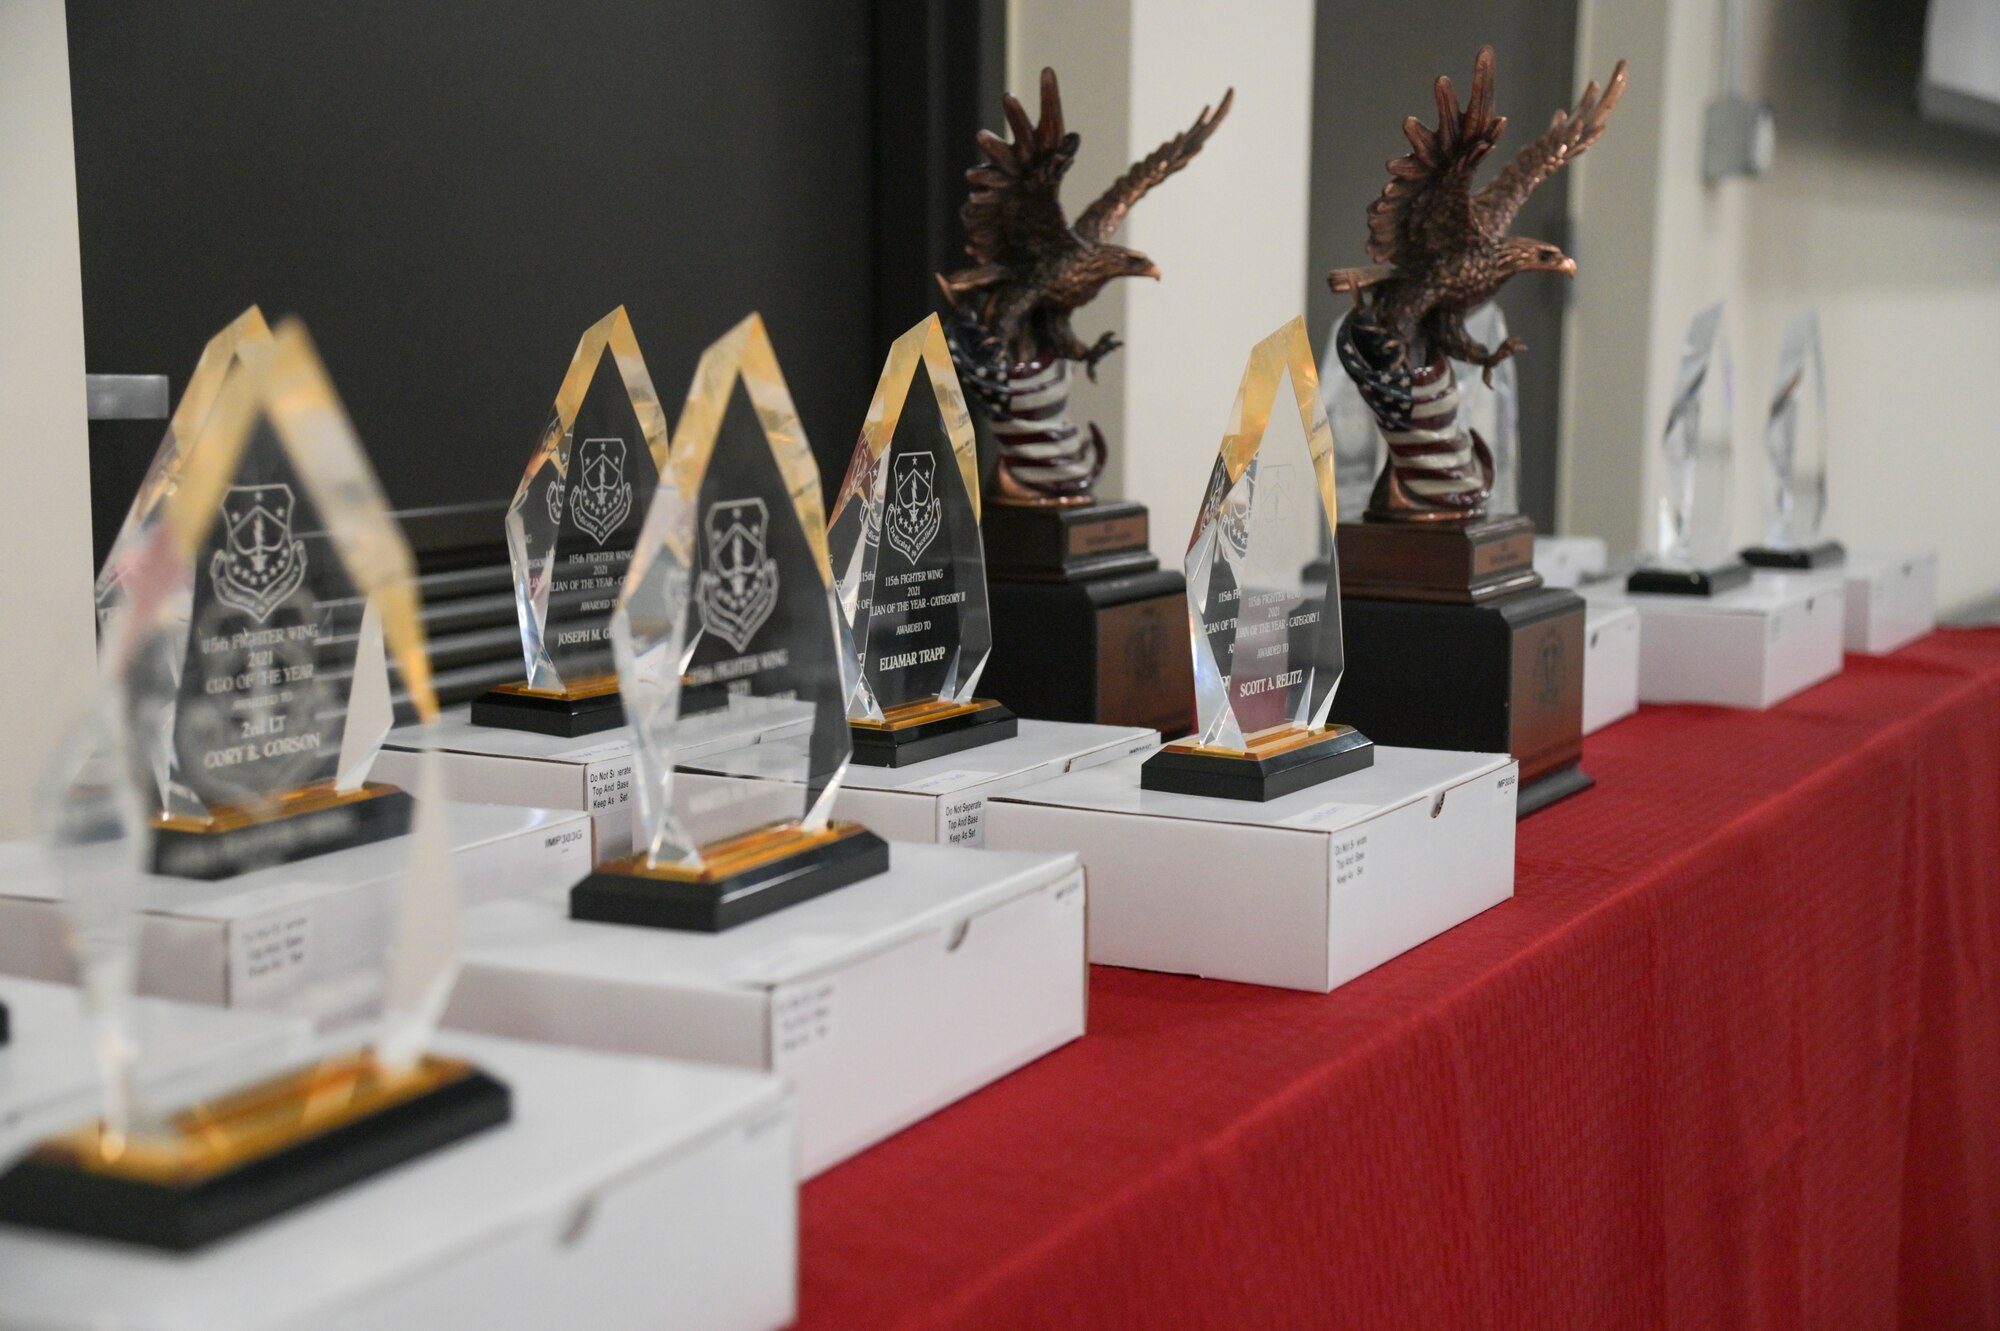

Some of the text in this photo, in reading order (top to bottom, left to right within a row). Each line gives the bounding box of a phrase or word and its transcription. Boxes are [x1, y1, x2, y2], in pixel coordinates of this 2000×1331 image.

[586, 551, 614, 563] FIGHTER
[594, 565, 608, 575] 2021
[886, 568, 944, 586] 115th FIGHTER WING
[570, 580, 579, 590] OF
[581, 579, 594, 590] THE
[596, 577, 613, 588] YEAR
[908, 586, 920, 597] 2021
[580, 600, 610, 611] AWARDED
[887, 603, 896, 614] OF
[897, 601, 910, 612] THE
[911, 598, 926, 609] YEAR
[930, 592, 961, 606] CATEGORY
[896, 620, 932, 635] AWARDED TO
[1272, 620, 1286, 631] YEAR
[1289, 612, 1316, 627] CATEGORY
[558, 630, 590, 648] JOSEPH
[592, 629, 601, 640] M.
[919, 646, 946, 664] TRAPP
[1240, 678, 1267, 698] SCOTT
[1267, 677, 1274, 691] A.
[1276, 670, 1302, 688] RELITZ
[590, 773, 598, 783] Do
[599, 772, 608, 781] Not
[592, 780, 629, 796] Top And Base
[594, 793, 628, 810] Keep As Set
[953, 805, 962, 814] Not
[948, 816, 978, 830] Top And Base
[962, 831, 968, 840] As
[968, 828, 976, 838] Set
